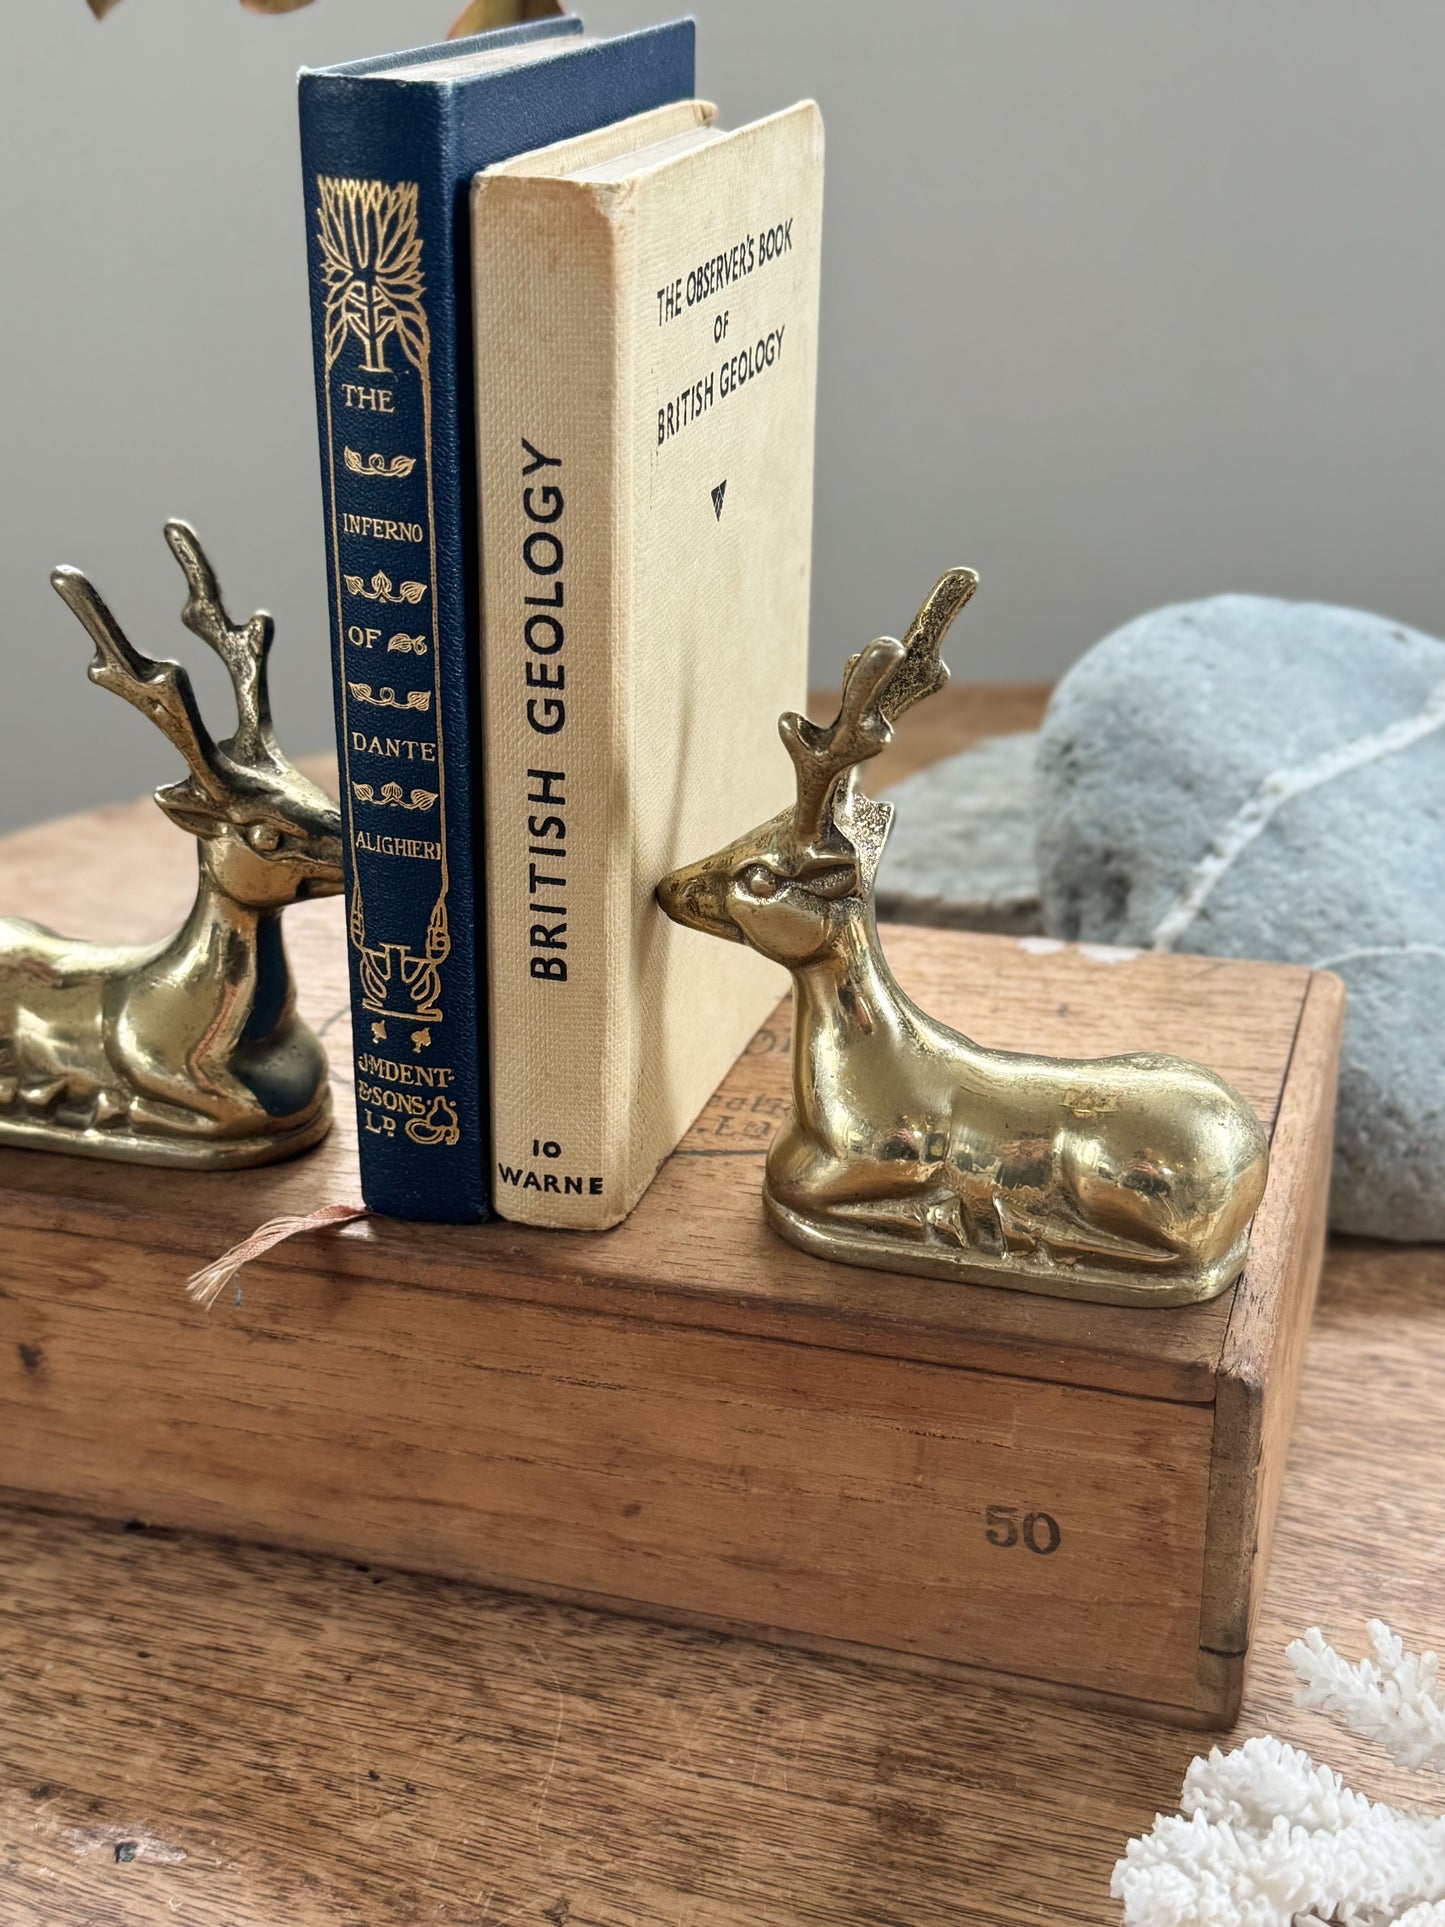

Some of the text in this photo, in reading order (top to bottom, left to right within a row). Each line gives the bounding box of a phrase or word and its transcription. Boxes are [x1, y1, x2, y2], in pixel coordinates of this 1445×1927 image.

[657, 217, 793, 326] THE OBSERVER'S BOOK
[713, 310, 729, 343] OF
[341, 384, 395, 413] THE
[657, 325, 785, 446] BRITISH GEOLOGY
[342, 513, 423, 542] INFERNO
[348, 625, 382, 649] OF
[521, 437, 568, 982] BRITISH GEOLOGY
[352, 732, 436, 762] DANTE
[355, 831, 441, 861] ALIGHIERI
[498, 1162, 604, 1195] WARNE
[985, 1504, 1061, 1555] 50
